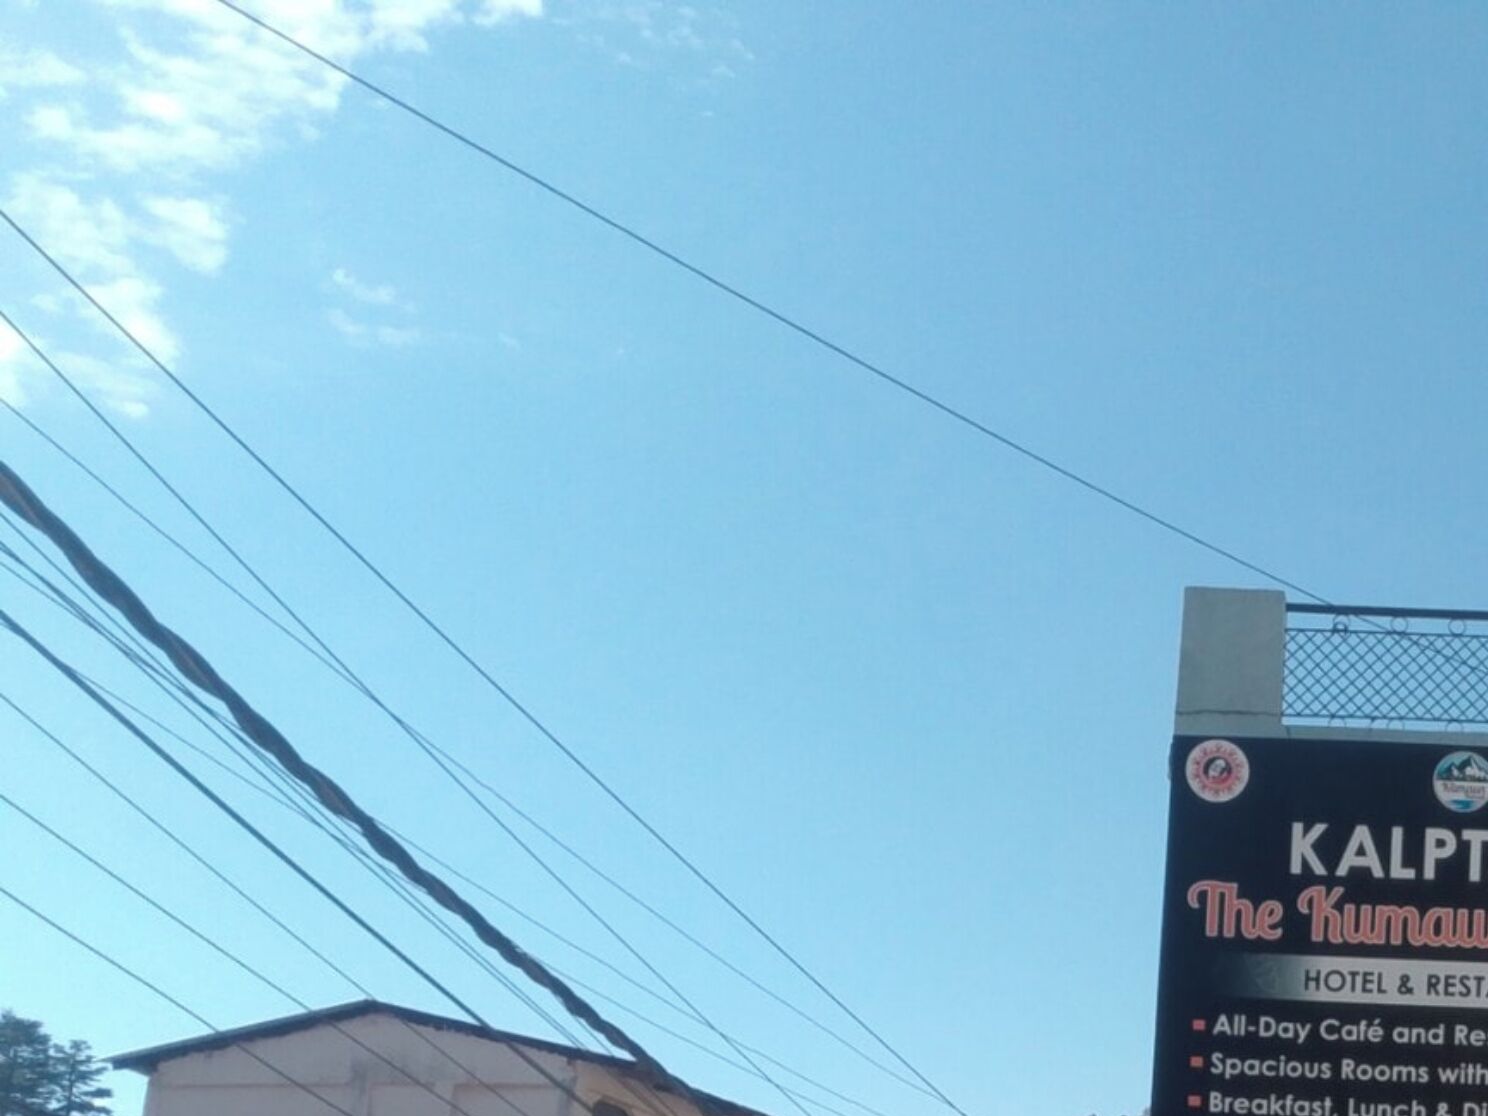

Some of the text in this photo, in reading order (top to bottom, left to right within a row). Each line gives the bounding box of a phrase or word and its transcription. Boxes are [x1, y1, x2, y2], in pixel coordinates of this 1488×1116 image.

[1186, 879, 1285, 941] The
[1304, 968, 1390, 996] HOTEL
[1396, 973, 1416, 996] &
[1212, 1013, 1310, 1044] All-Day
[1319, 1017, 1384, 1043] Café
[1391, 1022, 1447, 1047] and
[1209, 1053, 1333, 1086] Spacious
[1340, 1059, 1430, 1085] Rooms
